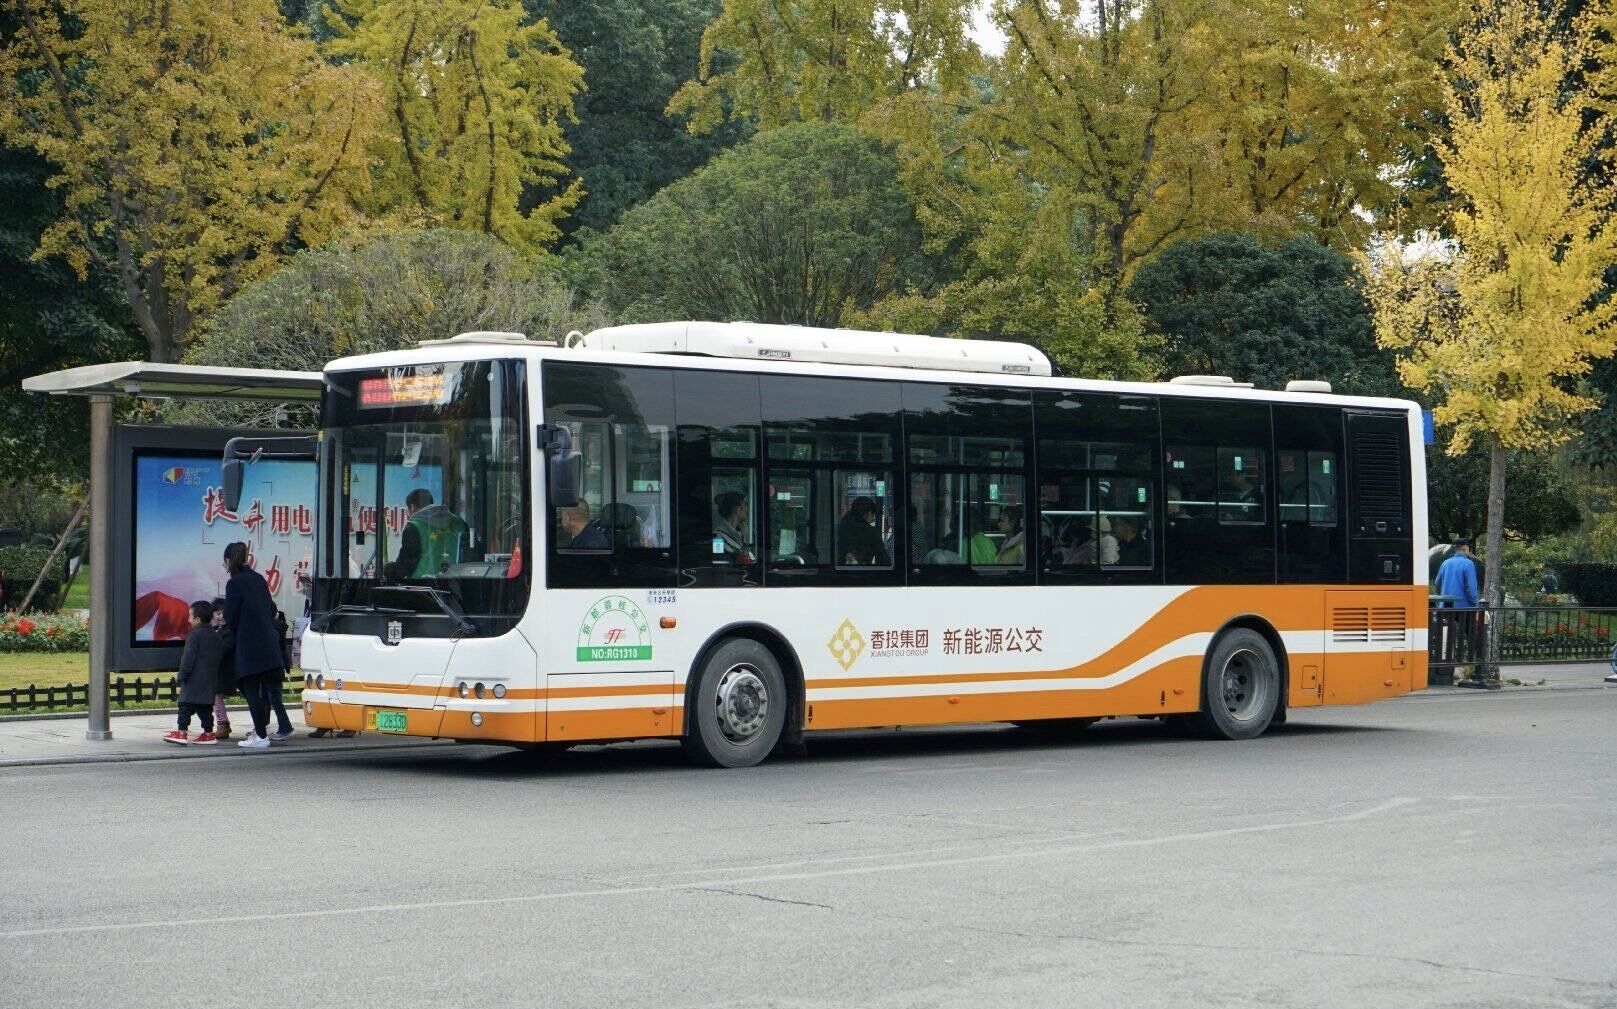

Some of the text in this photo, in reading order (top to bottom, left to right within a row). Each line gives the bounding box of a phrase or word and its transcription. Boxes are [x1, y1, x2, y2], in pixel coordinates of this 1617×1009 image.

[870, 626, 1043, 655] 香投集团 新能源公交
[591, 648, 638, 659] NO:RG1310
[870, 649, 929, 658] XIANGTOU GROUP
